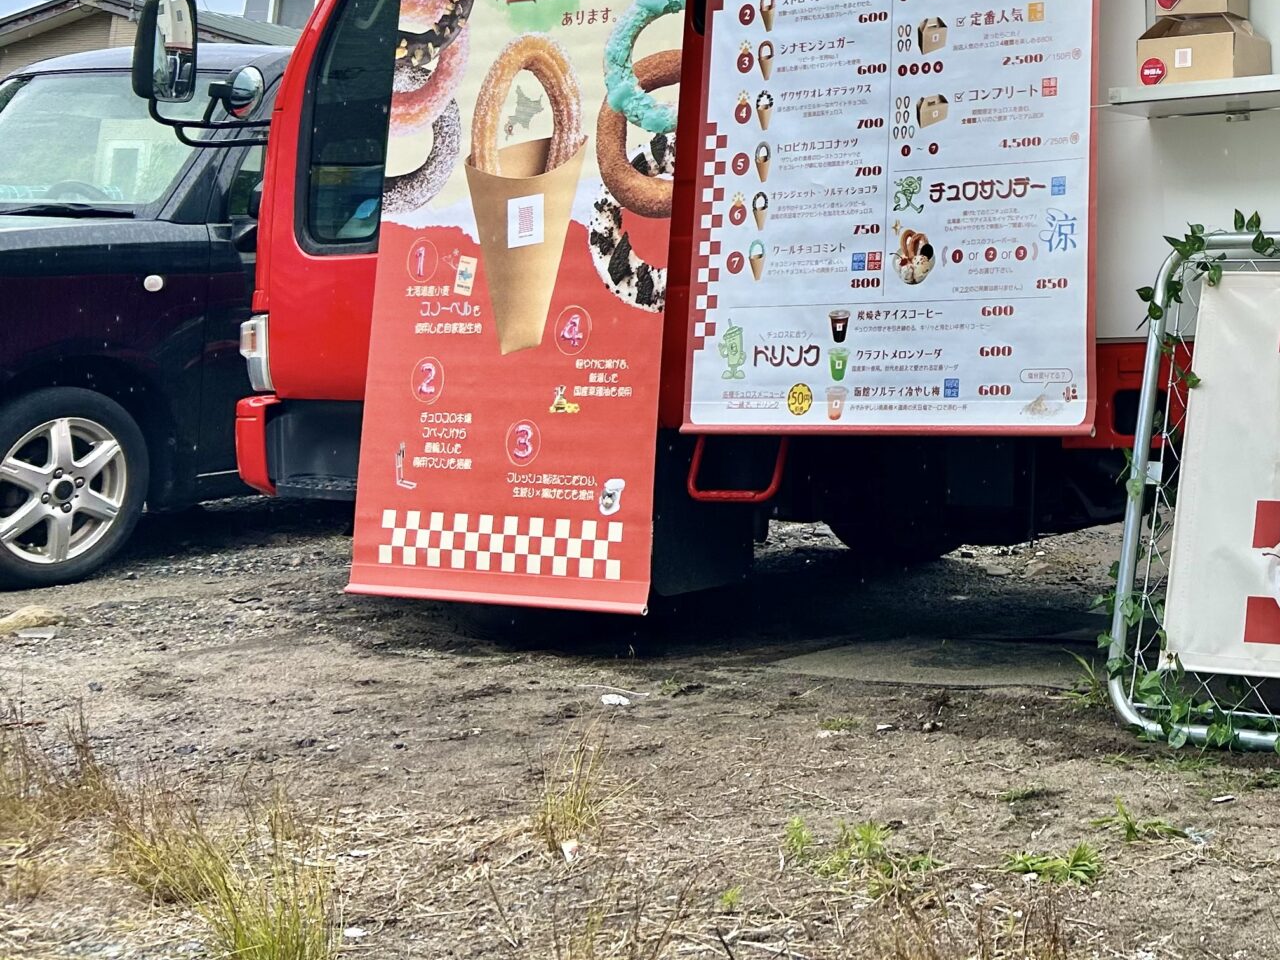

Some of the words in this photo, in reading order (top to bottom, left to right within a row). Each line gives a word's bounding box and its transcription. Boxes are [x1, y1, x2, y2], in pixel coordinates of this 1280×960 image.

[561, 7, 617, 26] あります。
[858, 11, 888, 24] 600
[970, 8, 1024, 27] 定番人気
[780, 37, 856, 55] シナモンシュガー
[857, 63, 887, 75] 600
[968, 84, 1039, 102] コンプリート
[857, 118, 884, 129] 700
[777, 138, 859, 153] トロピカルココナッツ
[855, 166, 882, 177] 700
[929, 177, 1046, 203] チュロサンデー
[853, 224, 880, 235] 750
[1041, 210, 1078, 252] 涼
[773, 243, 846, 255] クールチョコミント
[969, 251, 979, 260] or
[1001, 250, 1012, 260] or
[851, 278, 881, 289] 800
[1036, 278, 1068, 289] 850
[857, 308, 943, 321] 炭焼きアイスコーヒー
[981, 306, 1014, 317] 600
[753, 344, 821, 367] ドリンク
[856, 349, 943, 361] クラフトメロンソーダ
[979, 346, 1012, 357] 600
[854, 386, 940, 398] 函館ソルティ冷やし梅
[978, 385, 1011, 396] 600
[791, 392, 810, 406] 50円
